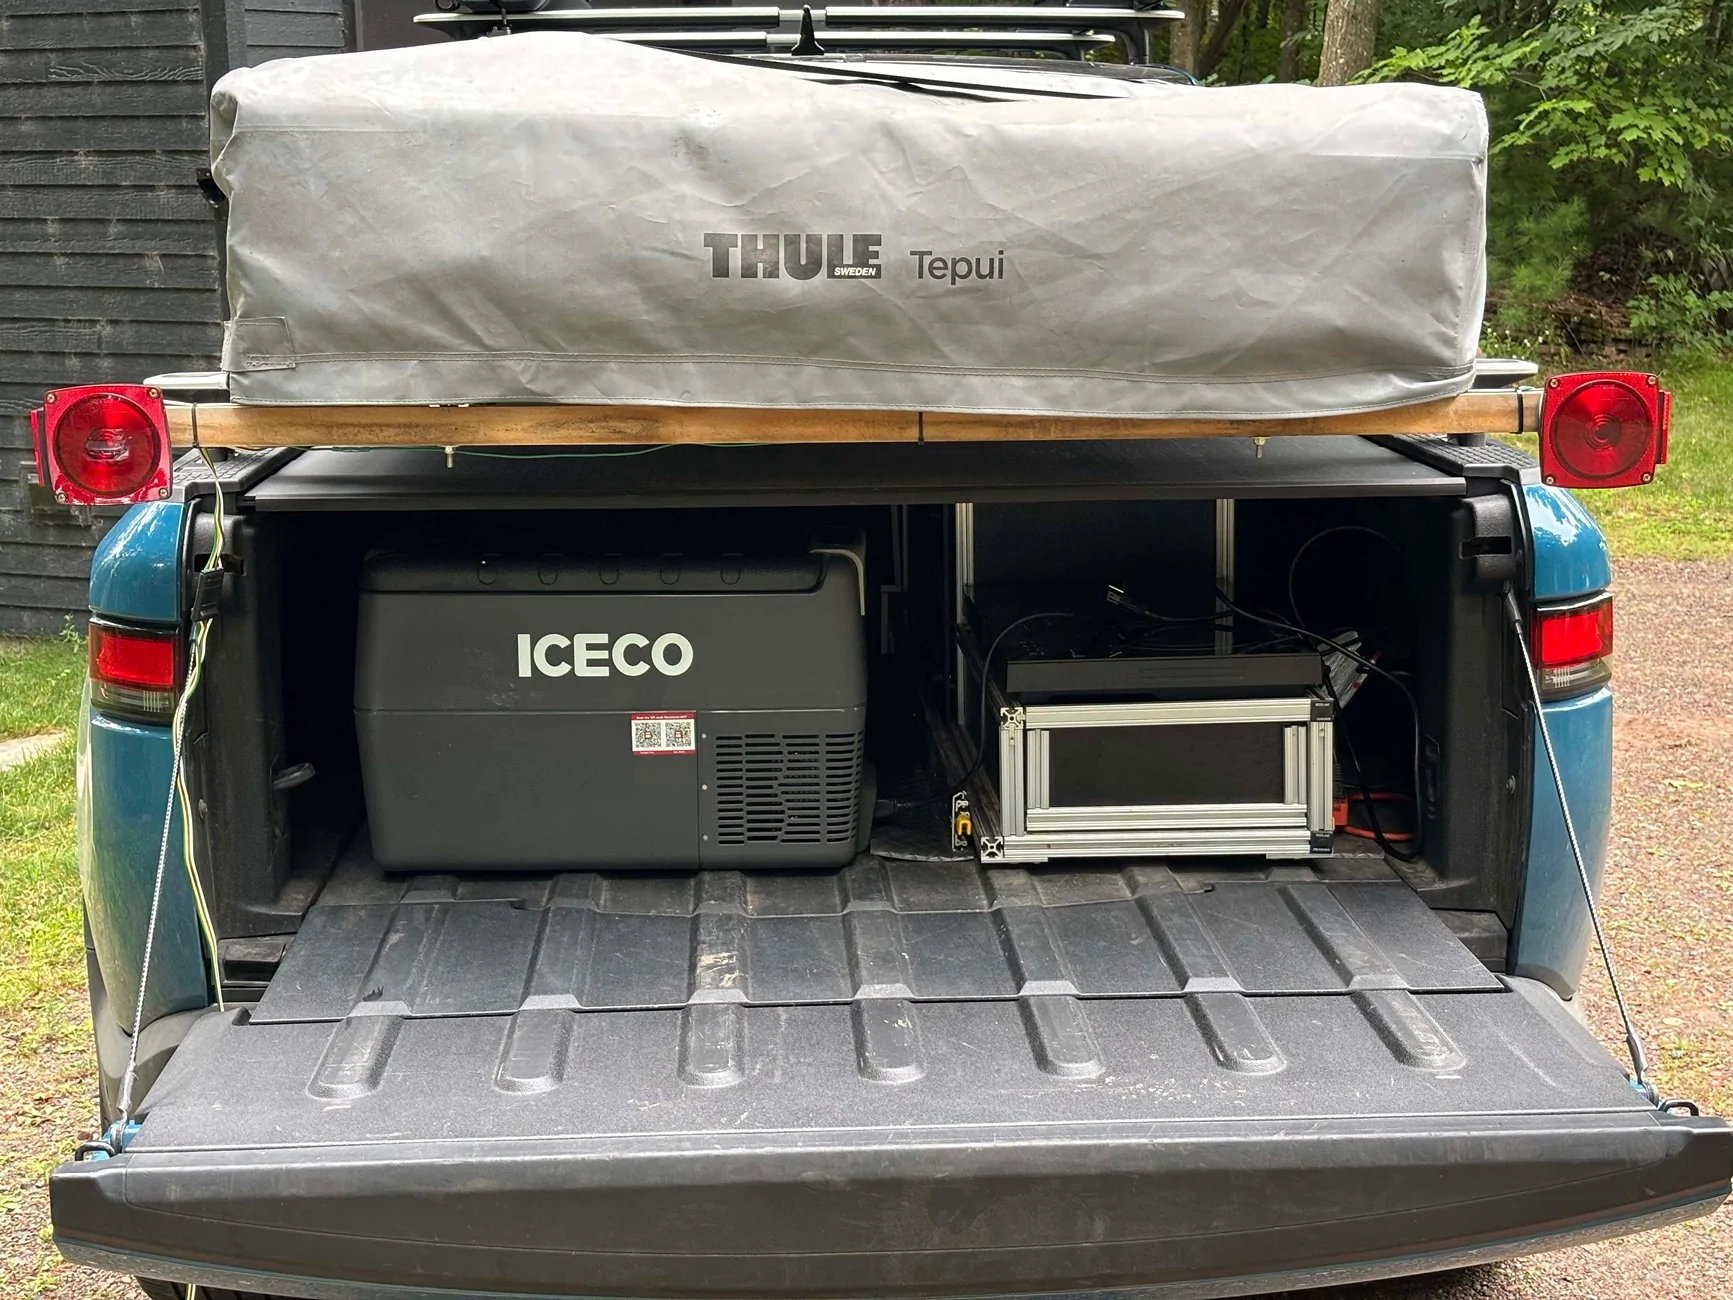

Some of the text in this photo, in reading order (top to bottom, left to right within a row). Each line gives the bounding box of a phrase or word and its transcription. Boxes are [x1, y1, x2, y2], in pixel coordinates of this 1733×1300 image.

[703, 232, 1005, 286] THULE Tepui
[833, 266, 877, 277] SWEDEN
[517, 632, 694, 678] ICECO
